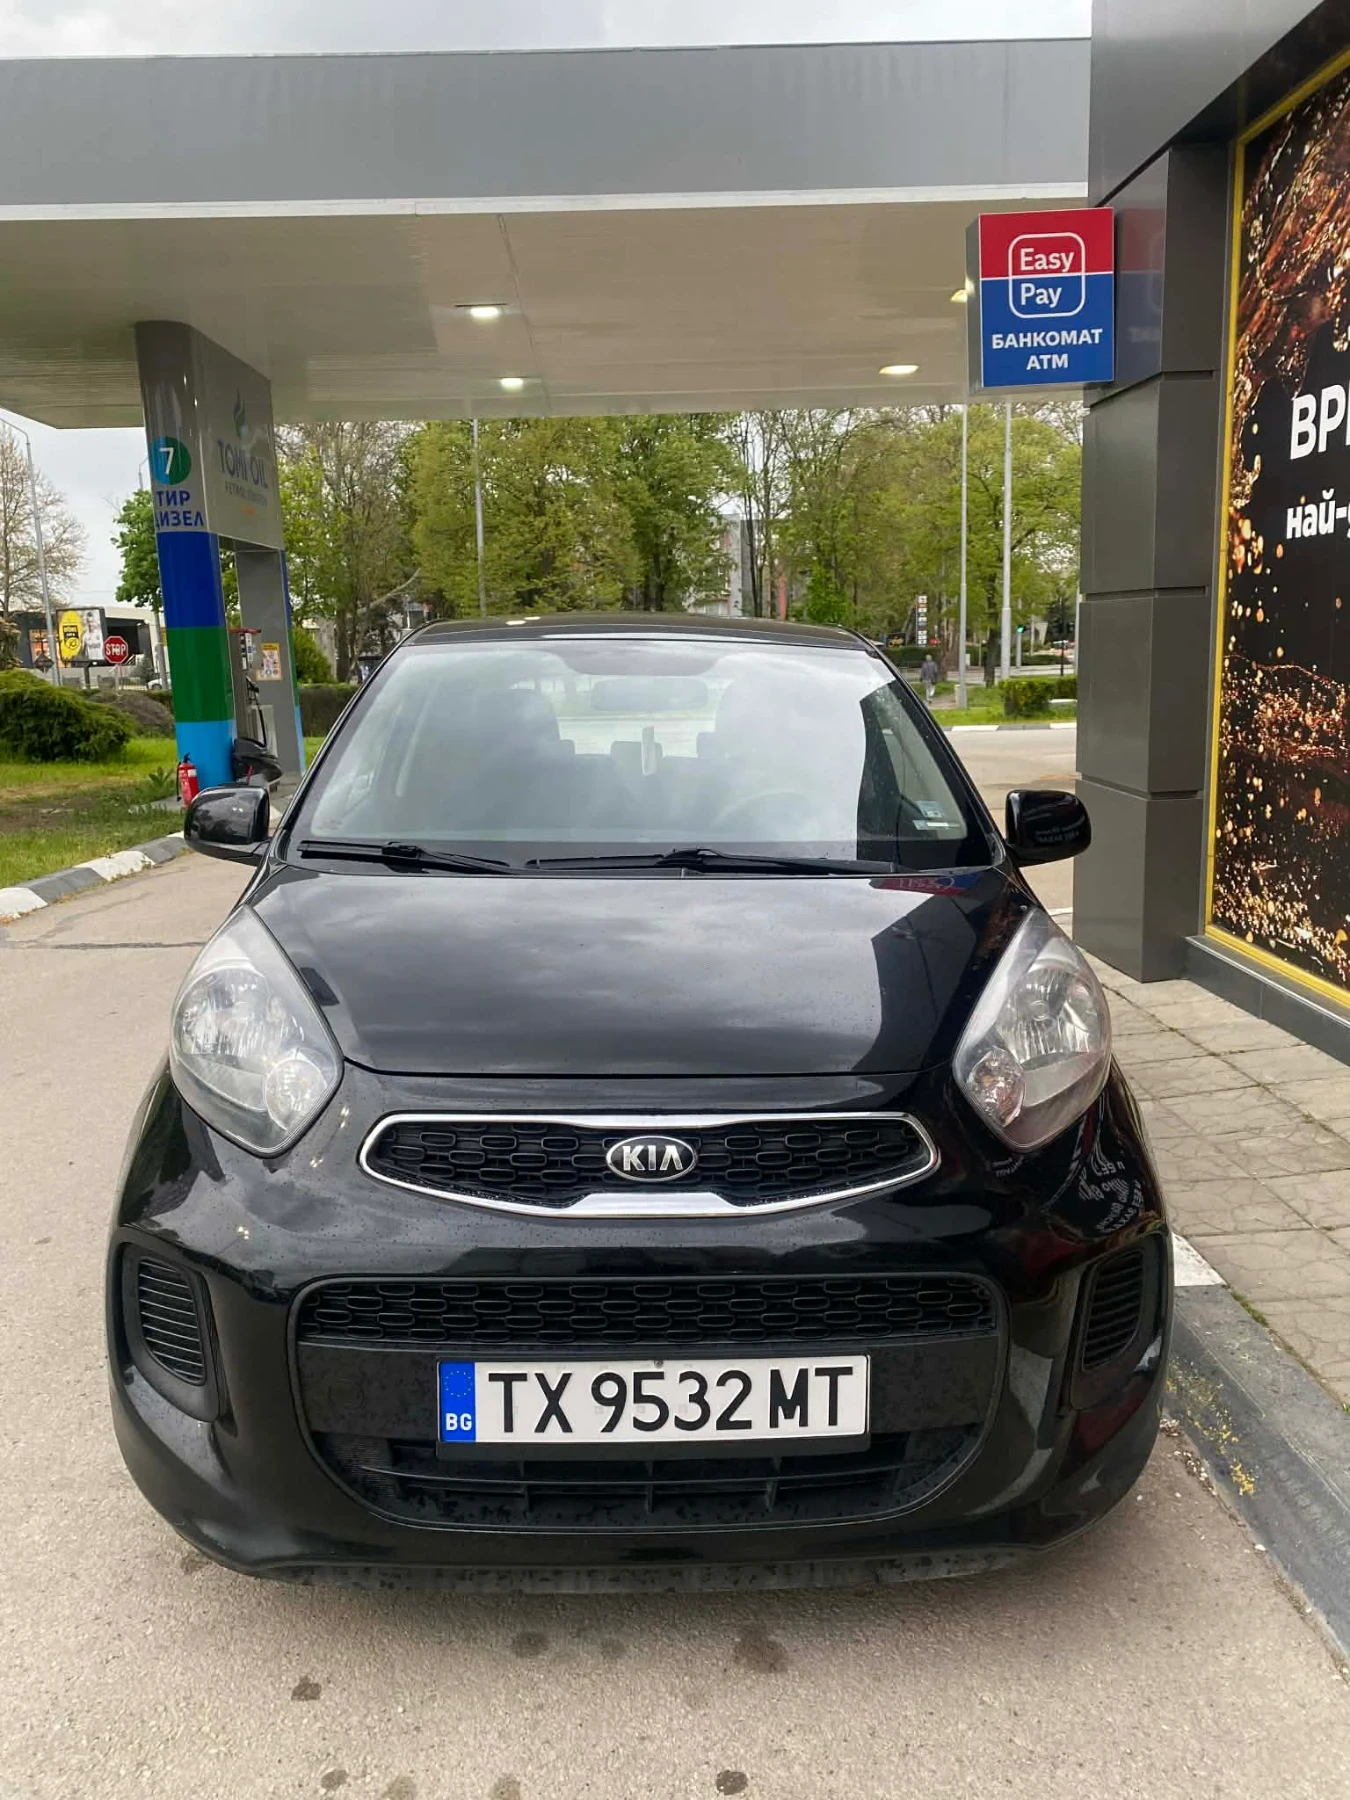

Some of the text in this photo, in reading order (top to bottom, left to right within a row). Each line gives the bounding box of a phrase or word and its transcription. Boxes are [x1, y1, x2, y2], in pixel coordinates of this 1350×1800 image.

[1020, 248, 1075, 273] Easy
[1020, 283, 1062, 308] Pay
[991, 328, 1103, 349] БАНКОМАТ
[1026, 354, 1069, 370] ATM
[1290, 380, 1350, 460] ВР
[159, 447, 175, 475] 7
[156, 490, 190, 507] ТИР
[1286, 488, 1350, 539] най-
[105, 643, 126, 656] STOP
[622, 1144, 684, 1171] KIA
[488, 1366, 853, 1433] TX 9532 MT
[445, 1412, 473, 1431] BG
